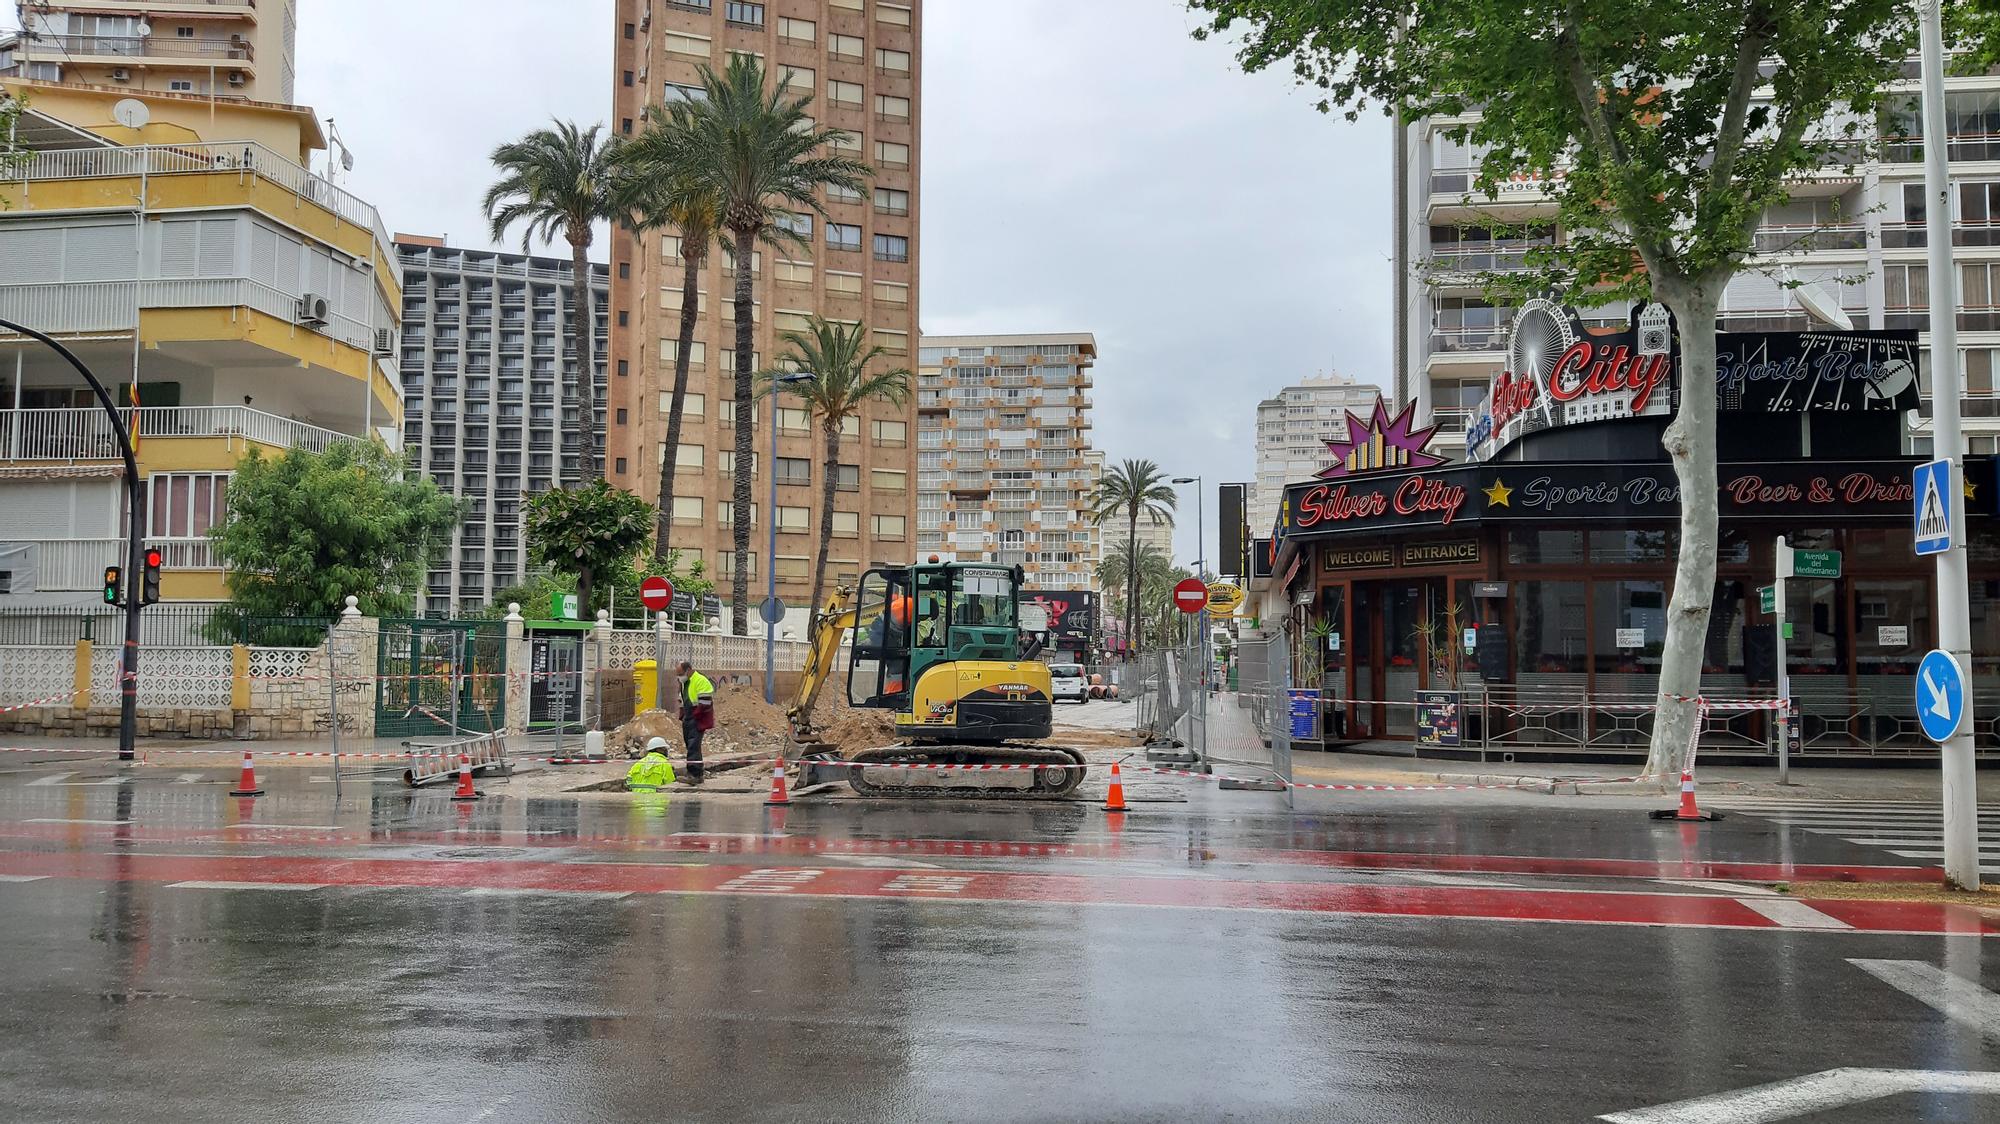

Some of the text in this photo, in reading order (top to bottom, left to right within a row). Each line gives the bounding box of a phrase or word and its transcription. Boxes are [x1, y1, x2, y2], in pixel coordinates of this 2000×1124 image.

[1815, 350, 1888, 381] Bar
[1548, 341, 1671, 412] City
[1296, 475, 1466, 527] Silver City
[1523, 476, 1618, 511] Sports
[1728, 475, 1802, 504] Beer
[1807, 476, 1835, 503] &
[1839, 472, 1914, 504] Drin
[1330, 544, 1476, 565] WELCOME ENTRANCE
[1804, 552, 1829, 560] Avenida
[1208, 584, 1236, 594] BISONTE
[564, 602, 577, 610] ATM
[999, 684, 1029, 692] YANMAR
